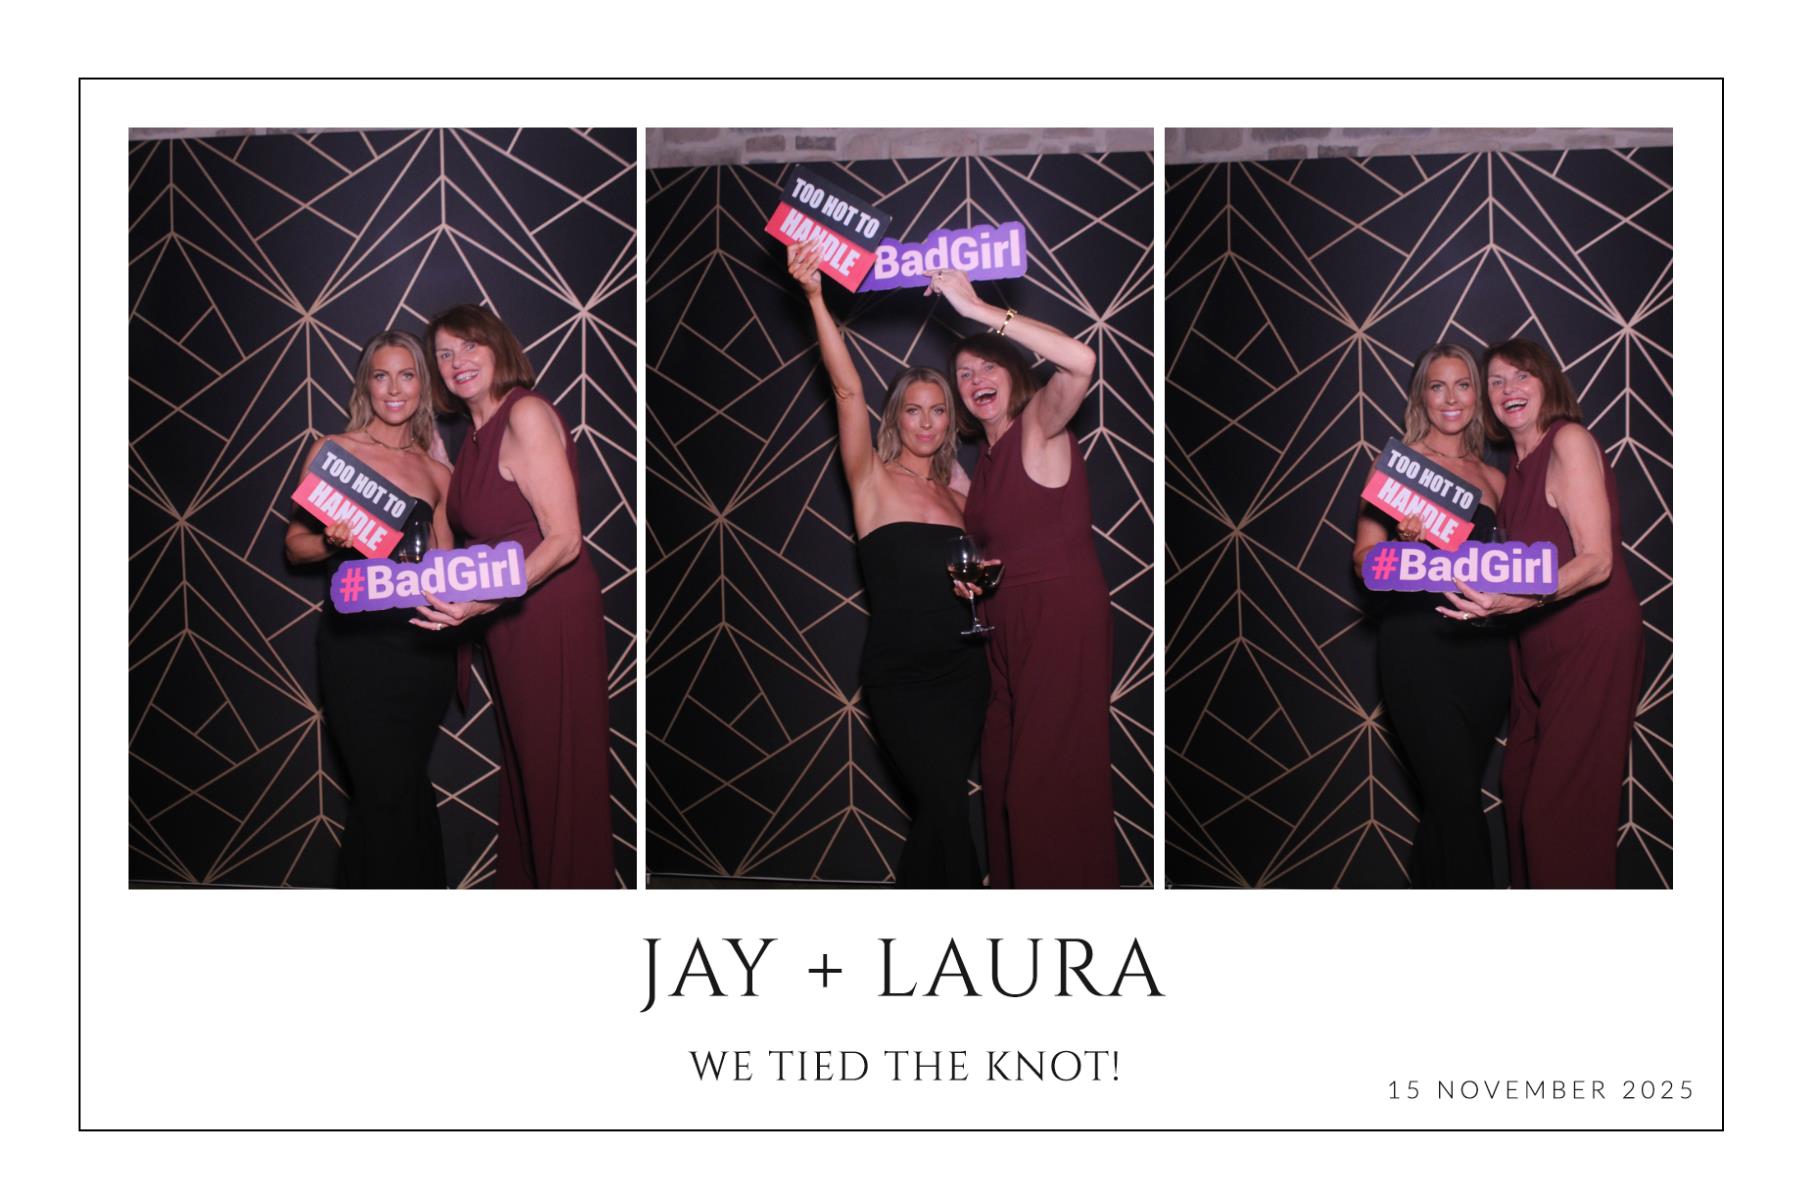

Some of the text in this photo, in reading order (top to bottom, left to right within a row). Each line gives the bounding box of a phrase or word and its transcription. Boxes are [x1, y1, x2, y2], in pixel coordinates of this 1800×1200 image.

[791, 177, 880, 239] TOO HOT TO
[321, 451, 407, 519] TOO HOT TO
[1386, 449, 1474, 510] TOO HOT TO
[340, 548, 521, 604] #BadGirl
[1371, 547, 1553, 584] #BadGirl
